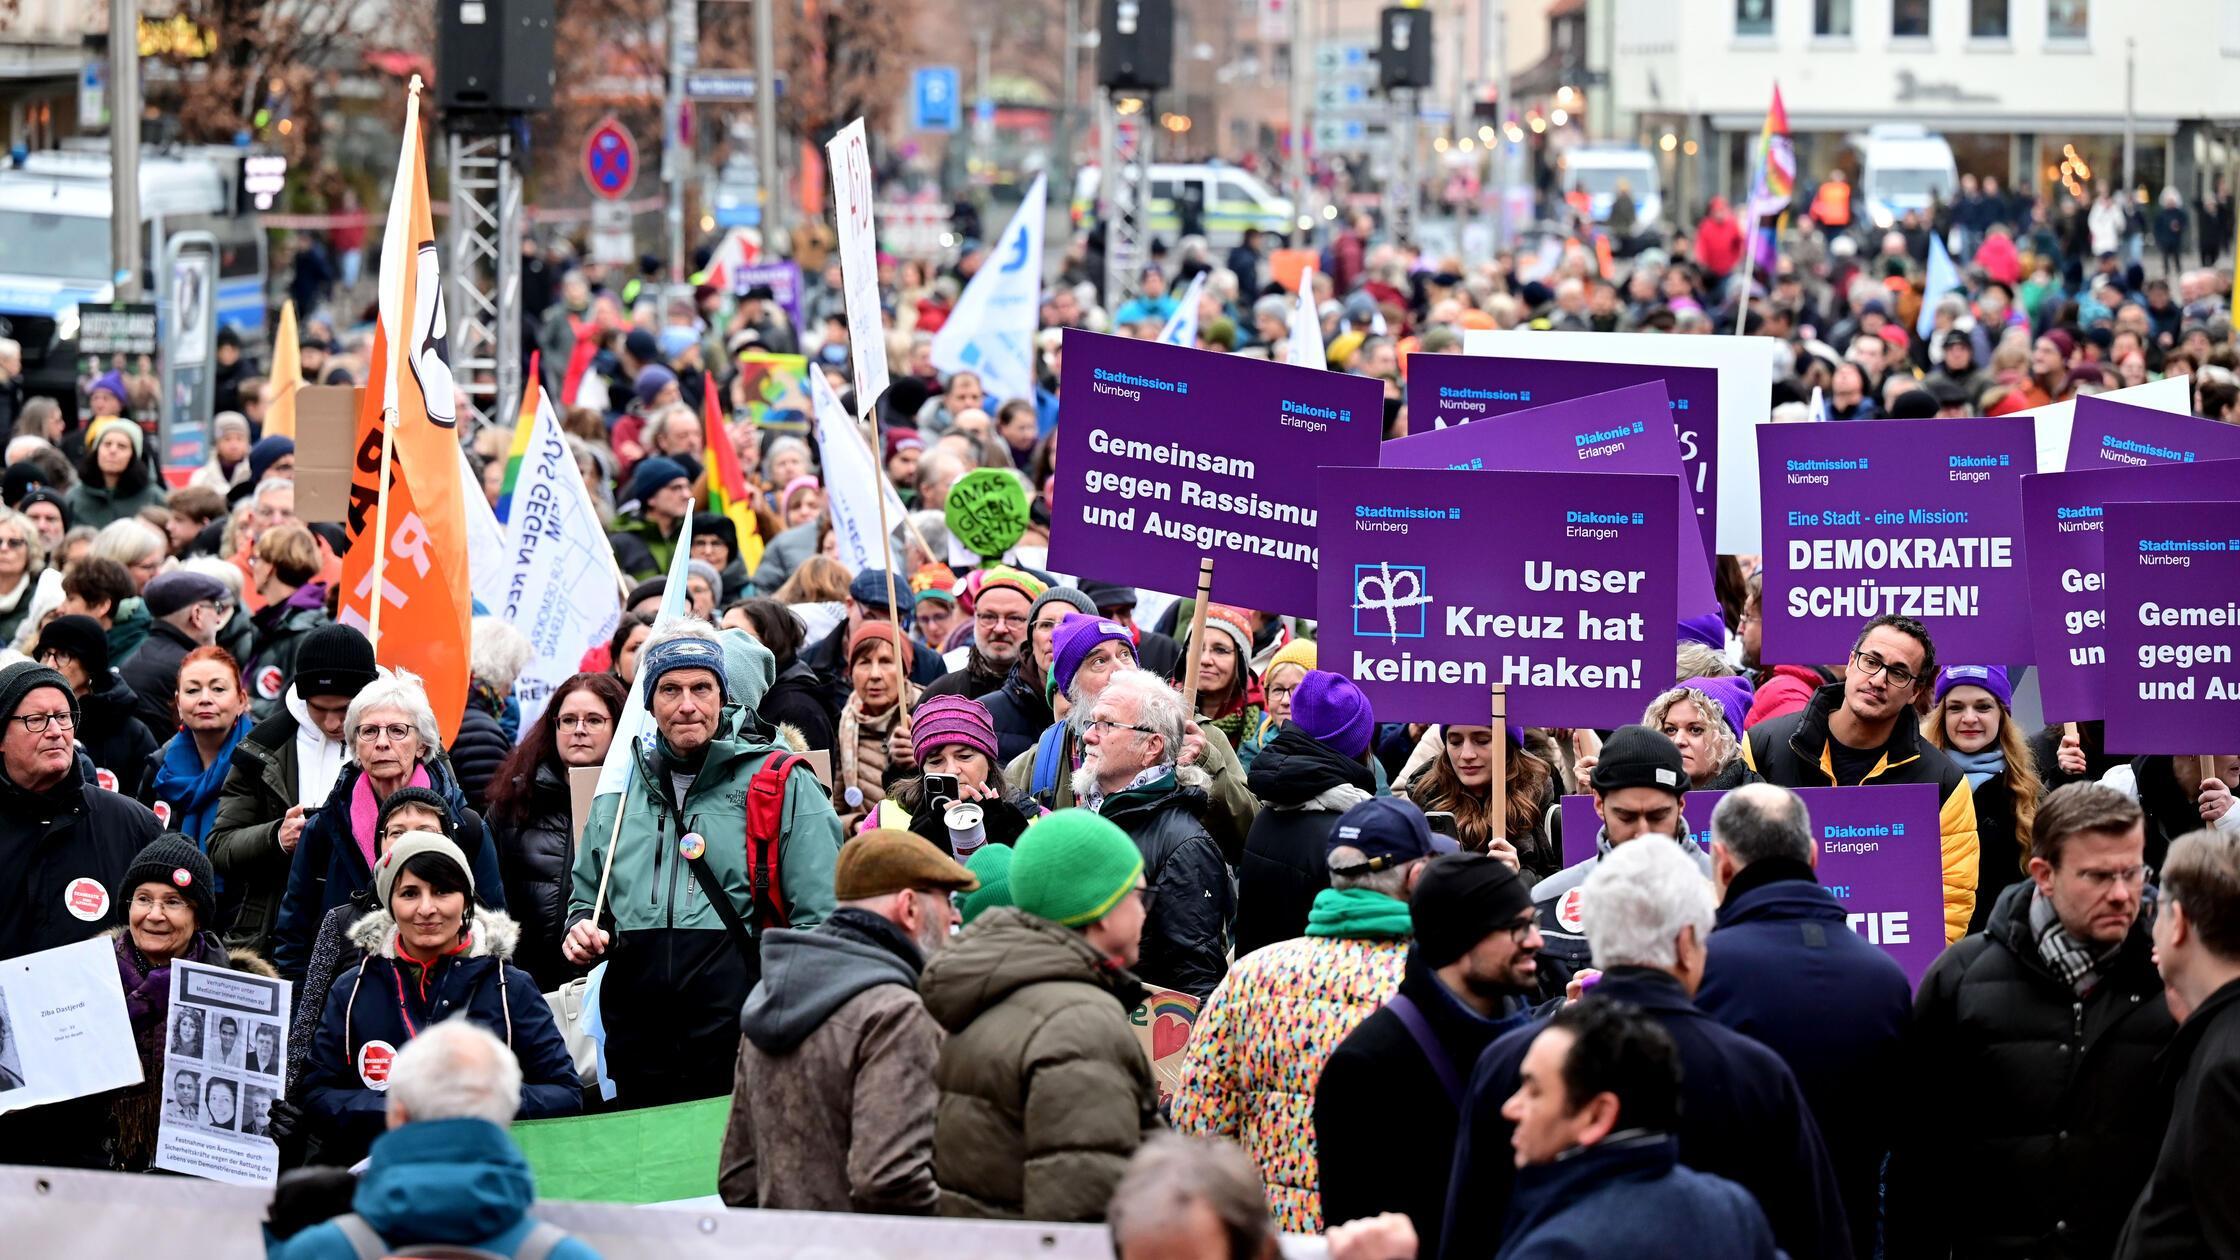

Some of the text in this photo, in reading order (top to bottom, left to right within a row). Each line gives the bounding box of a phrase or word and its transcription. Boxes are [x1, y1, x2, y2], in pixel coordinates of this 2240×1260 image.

[1093, 368, 1174, 392] Stadtmission
[1093, 382, 1140, 401] Nürnberg
[1440, 387, 1518, 401] Stadtmission
[1282, 400, 1337, 420] Diakonie
[1440, 399, 1486, 412] Nürnberg
[1280, 415, 1327, 432] Erlangen
[1575, 425, 1630, 446] Diakonie
[1088, 429, 1254, 480] Gemeinsam
[1578, 441, 1625, 460] Erlangen
[2102, 435, 2181, 461] Stadtmission
[1787, 459, 1857, 471] Stadtmission
[1949, 455, 1998, 467] Diakonie
[1788, 473, 1828, 485] Nürnberg
[1950, 470, 1990, 482] Erlangen
[1085, 469, 1317, 527] gegen Rassismu
[1082, 504, 1135, 530] und
[1355, 505, 1446, 520] Stadtmission
[1566, 512, 1629, 524] Diakonie
[1788, 512, 1819, 526] Eine
[1822, 510, 1860, 526] Stadt
[1874, 510, 1904, 524] eine
[1909, 509, 1968, 524] Mission:
[2057, 506, 2103, 519] Stadtm
[1355, 520, 1408, 534] Nürnberg
[1566, 526, 1618, 540] Erlangen
[1788, 537, 2012, 570] DEMOKRATIE
[2138, 540, 2226, 551] Stadtmission
[2139, 554, 2190, 567] Nürnberg
[1524, 560, 1646, 593] Unser
[2062, 568, 2104, 592] Ge
[1788, 579, 1978, 618] SCHÜTZEN!
[1446, 606, 1644, 641] Kreuz hat
[2069, 647, 2105, 666] un
[2138, 644, 2231, 668] gegen
[1353, 651, 1642, 689] keinen Haken!
[2138, 677, 2195, 700] und
[1824, 825, 1888, 838] Diakonie
[1825, 840, 1878, 854] Erlangen
[1847, 912, 1910, 945] TIE
[40, 1001, 85, 1018] Ziba Dastjerdi
[175, 1136, 204, 1148] Festnahme
[246, 1152, 262, 1160] durch
[164, 1144, 210, 1159] Sicherheitskräfte
[211, 1156, 230, 1164] wegen
[240, 1160, 260, 1172] Rettung
[166, 1154, 186, 1163] Lebens
[187, 1158, 198, 1166] von
[198, 1160, 248, 1176] Demonstrierenden
